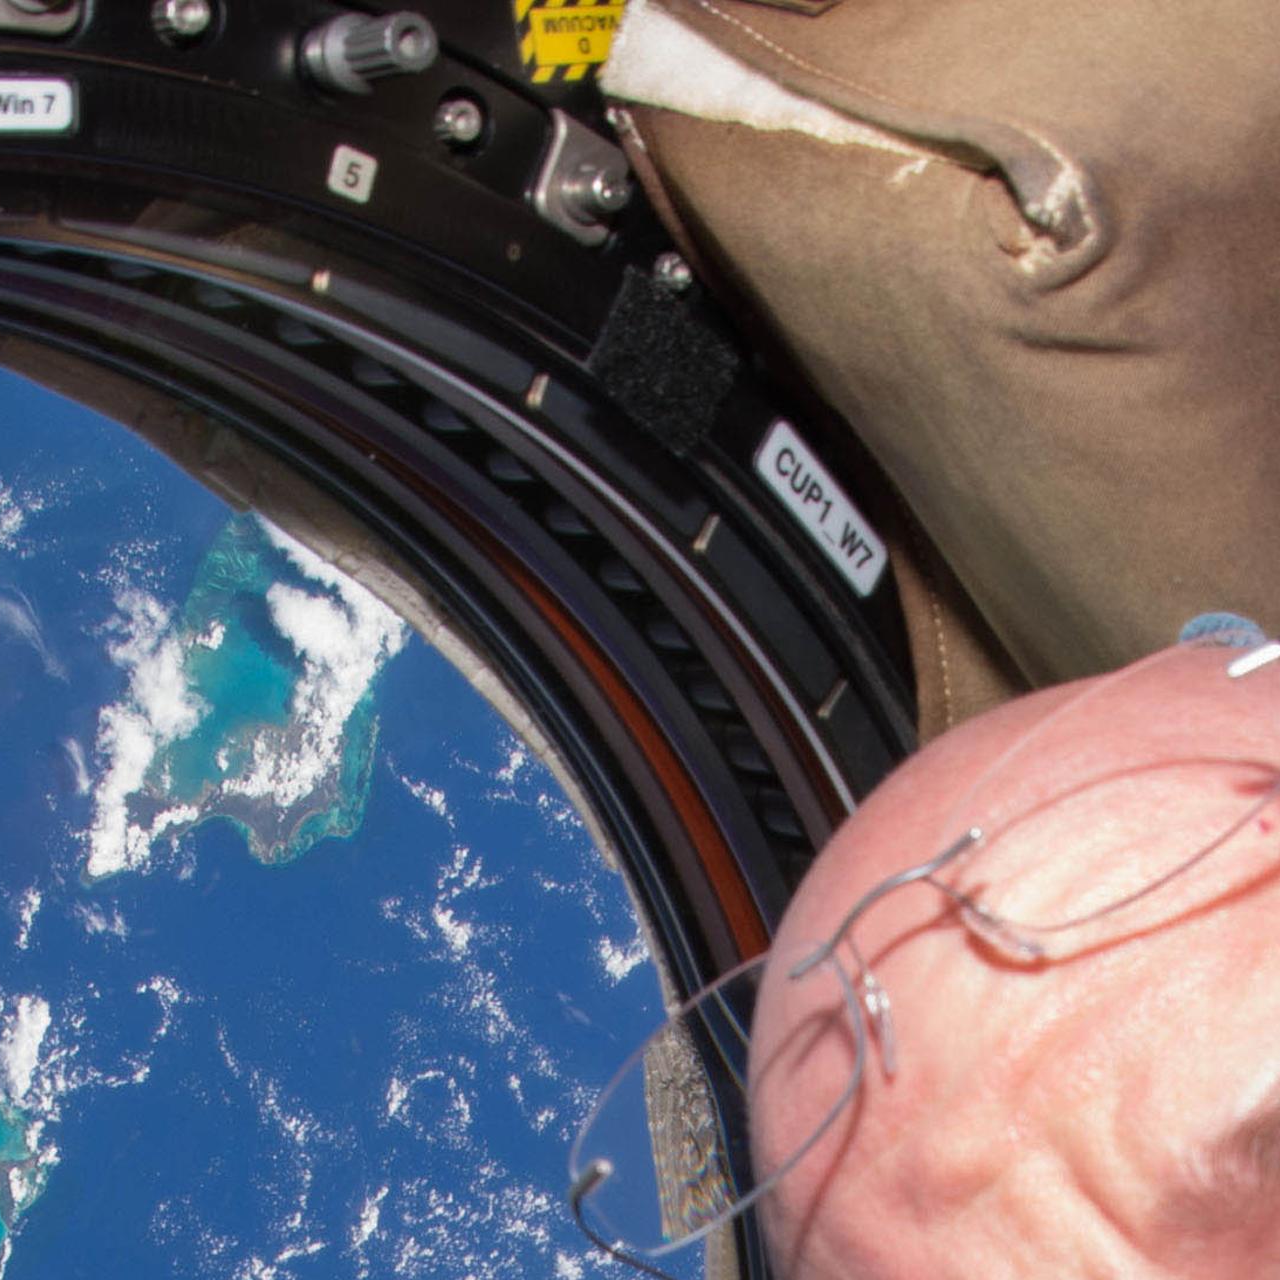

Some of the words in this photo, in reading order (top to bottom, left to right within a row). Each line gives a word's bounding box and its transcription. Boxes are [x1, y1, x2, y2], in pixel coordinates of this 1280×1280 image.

[543, 15, 620, 33] VACUUM
[43, 94, 56, 114] 7
[343, 162, 362, 188] 5
[775, 447, 873, 569] CUP1_W7
